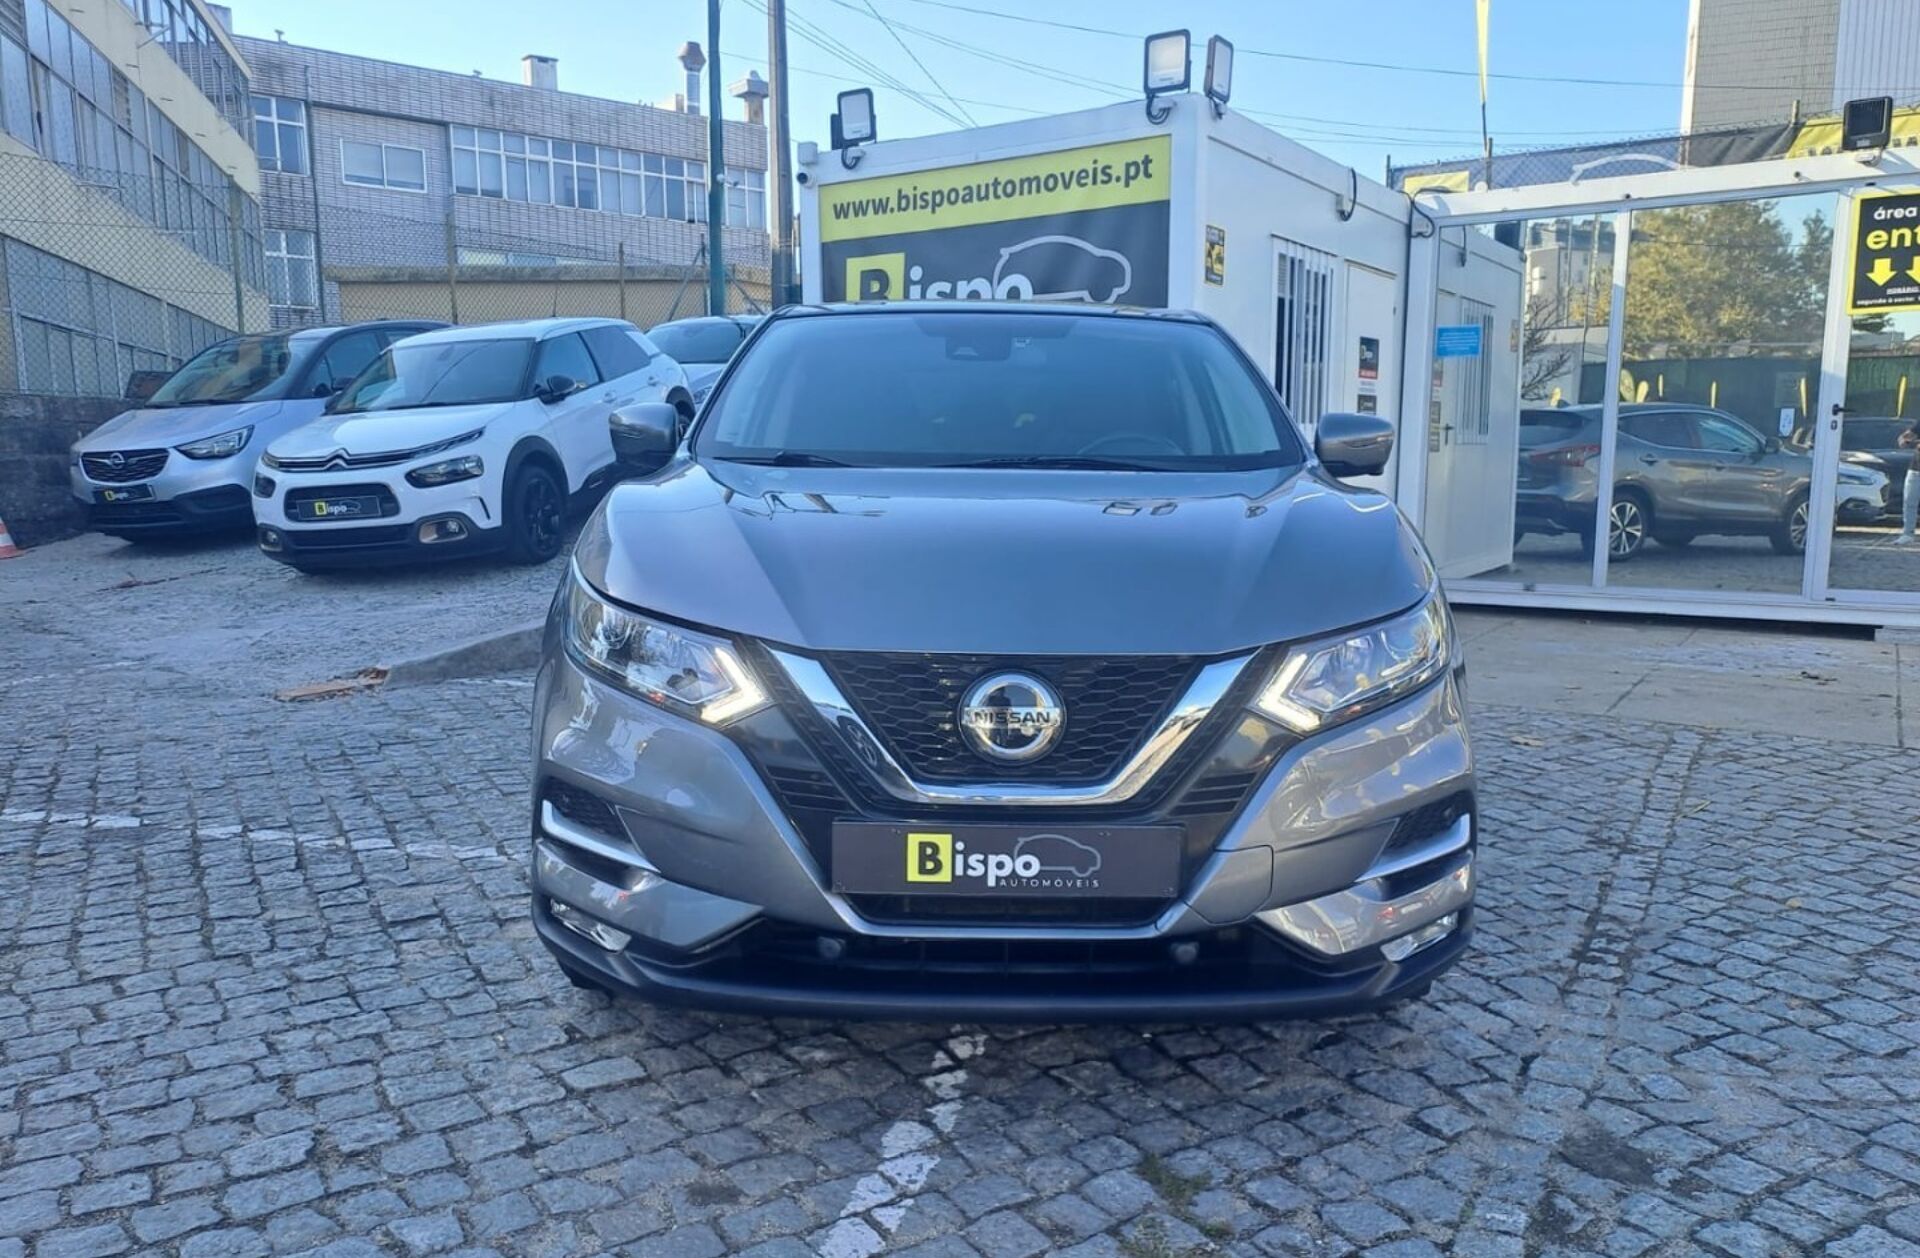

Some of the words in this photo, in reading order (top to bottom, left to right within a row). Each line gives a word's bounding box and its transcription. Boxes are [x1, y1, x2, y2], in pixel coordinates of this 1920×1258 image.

[832, 153, 1153, 221] www.bispoautomoveis.pt
[1873, 205, 1918, 221] área
[974, 711, 1050, 724] NISSAN
[917, 840, 1041, 888] Bispo
[1000, 877, 1100, 888] AUTOMÓVEIS
